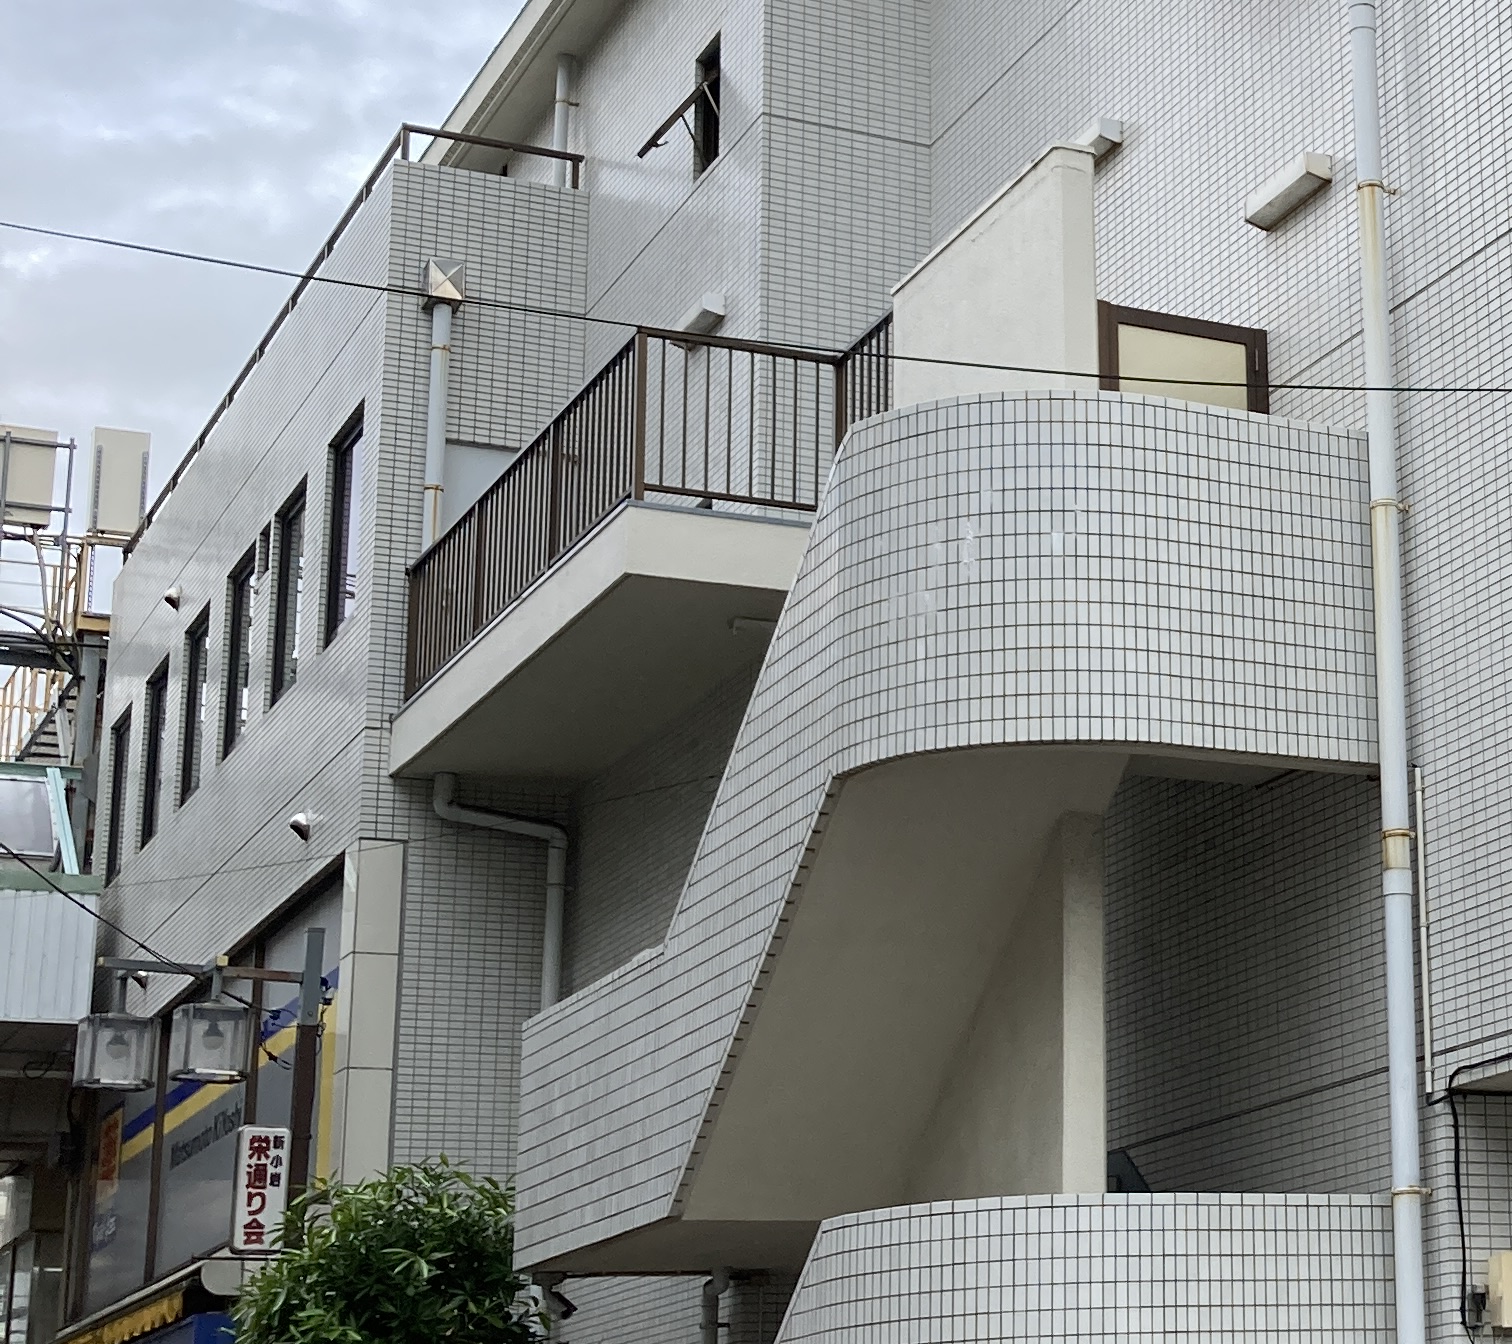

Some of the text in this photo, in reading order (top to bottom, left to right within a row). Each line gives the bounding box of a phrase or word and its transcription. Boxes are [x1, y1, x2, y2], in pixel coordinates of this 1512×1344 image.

[243, 1135, 271, 1246] 栄通り会
[269, 1135, 285, 1188] 新小岩
